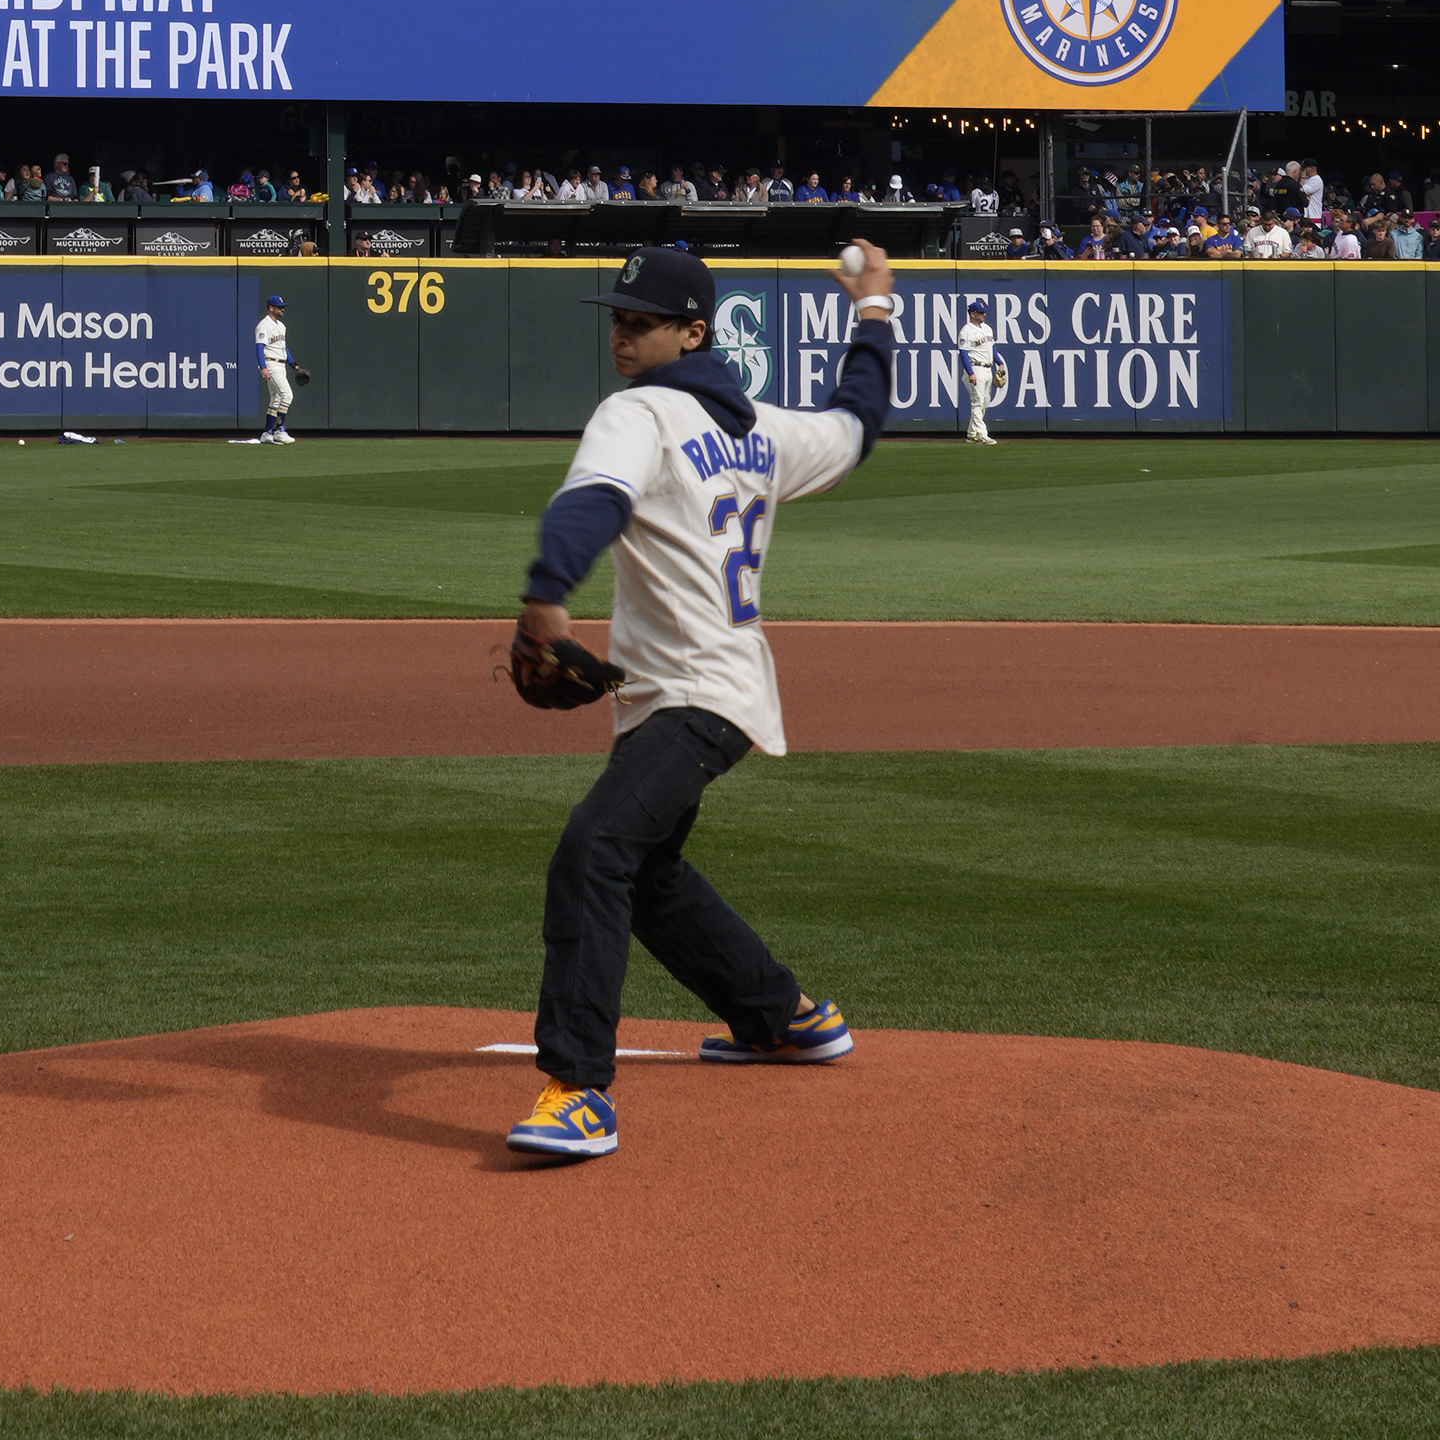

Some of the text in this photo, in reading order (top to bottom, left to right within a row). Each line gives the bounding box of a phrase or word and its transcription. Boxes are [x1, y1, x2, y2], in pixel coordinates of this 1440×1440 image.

[2, 20, 56, 88] AT
[70, 20, 152, 89] THE
[169, 22, 293, 91] PARK
[1020, 3, 1158, 67] MARINERS
[1285, 90, 1337, 118] BAR
[980, 198, 995, 212] 24
[144, 244, 198, 252] MUCKLESHOOT
[367, 270, 446, 315] 376
[17, 303, 153, 340] Mason
[1071, 292, 1199, 345] CARE
[797, 349, 1201, 410] FUNATION
[681, 429, 776, 483] RALEIGH
